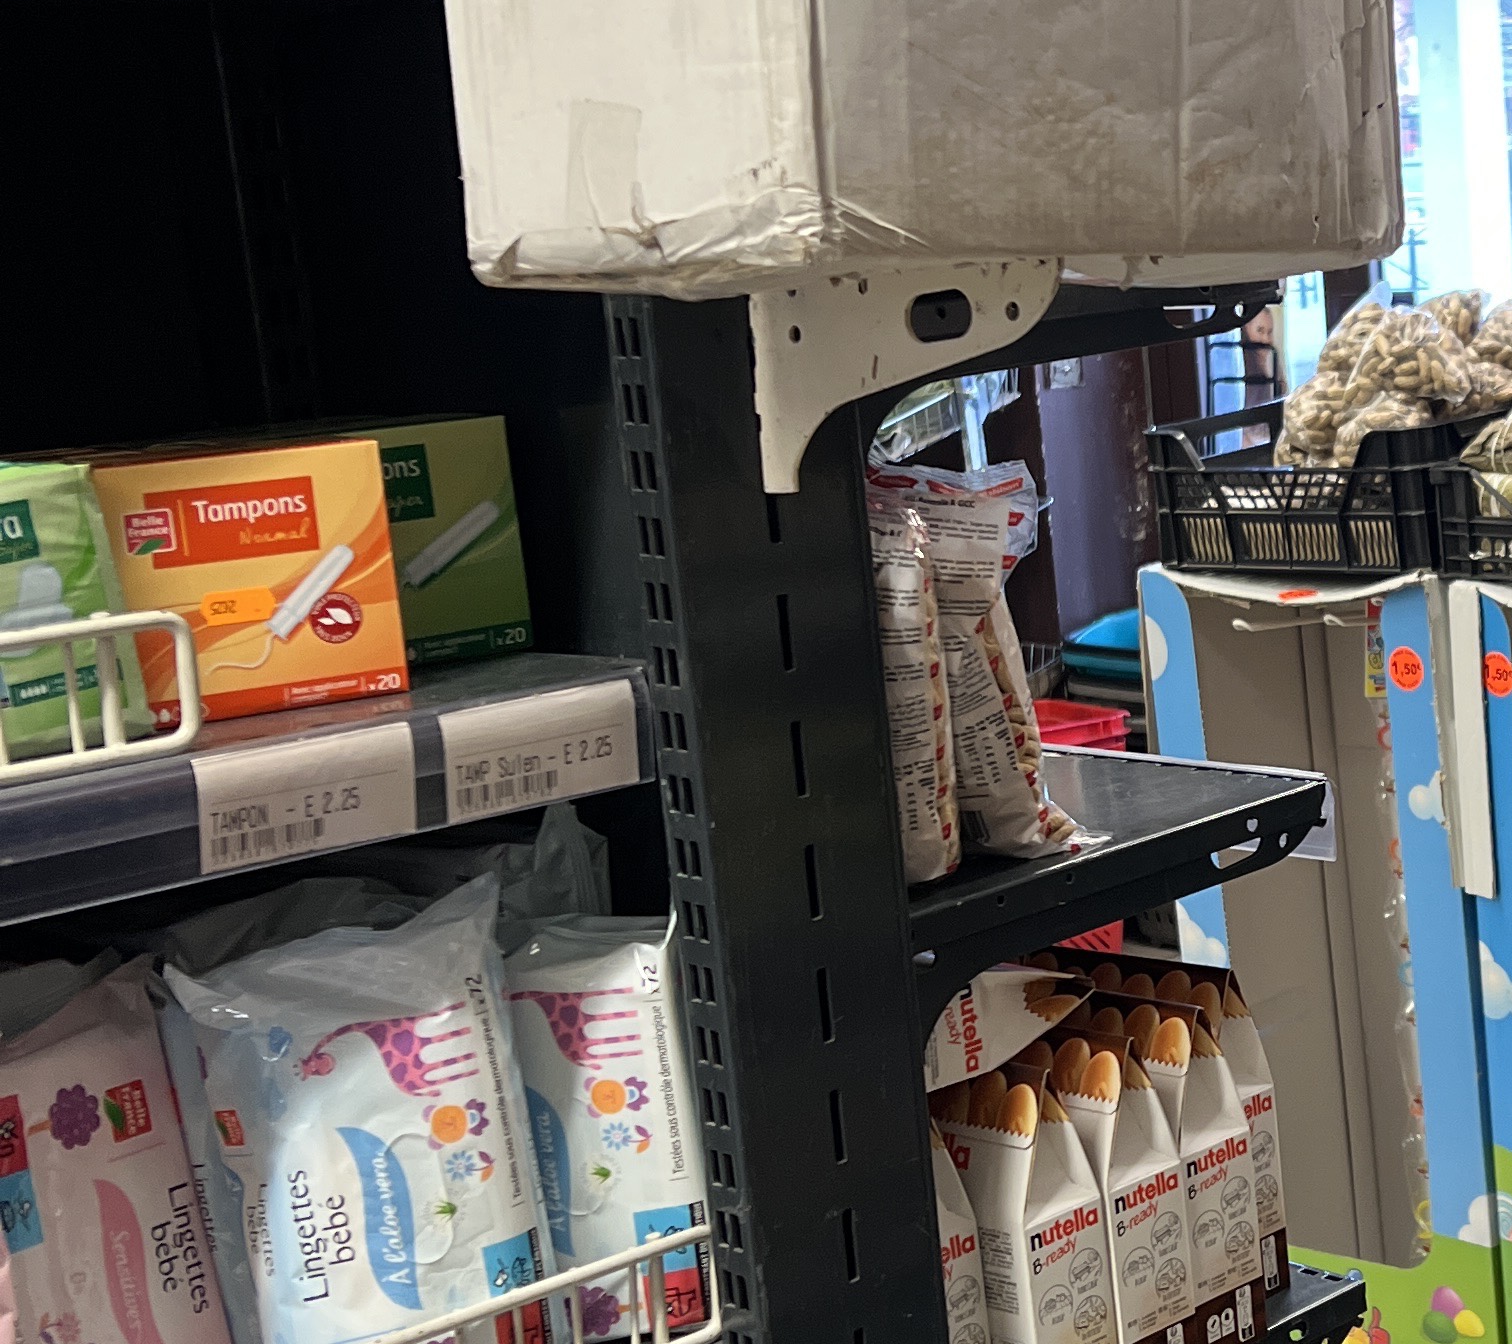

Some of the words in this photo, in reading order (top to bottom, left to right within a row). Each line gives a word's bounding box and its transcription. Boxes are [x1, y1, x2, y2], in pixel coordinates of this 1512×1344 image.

[192, 494, 307, 524] Tampons
[239, 517, 310, 545] Normal
[563, 743, 573, 765] E
[579, 735, 613, 761] 2.25
[303, 796, 315, 818] E
[323, 787, 361, 815] 2.25
[1243, 1094, 1273, 1122] ella
[1187, 1136, 1248, 1179] nutella
[1115, 1171, 1179, 1215] nutella
[1188, 1165, 1229, 1200] B-ready
[287, 1169, 330, 1304] Lingettes
[1030, 1207, 1099, 1253] nutella
[1116, 1200, 1158, 1238] B-ready
[168, 1182, 210, 1314] Lingettes
[940, 1234, 975, 1267] ella
[1032, 1237, 1077, 1276] B-ready
